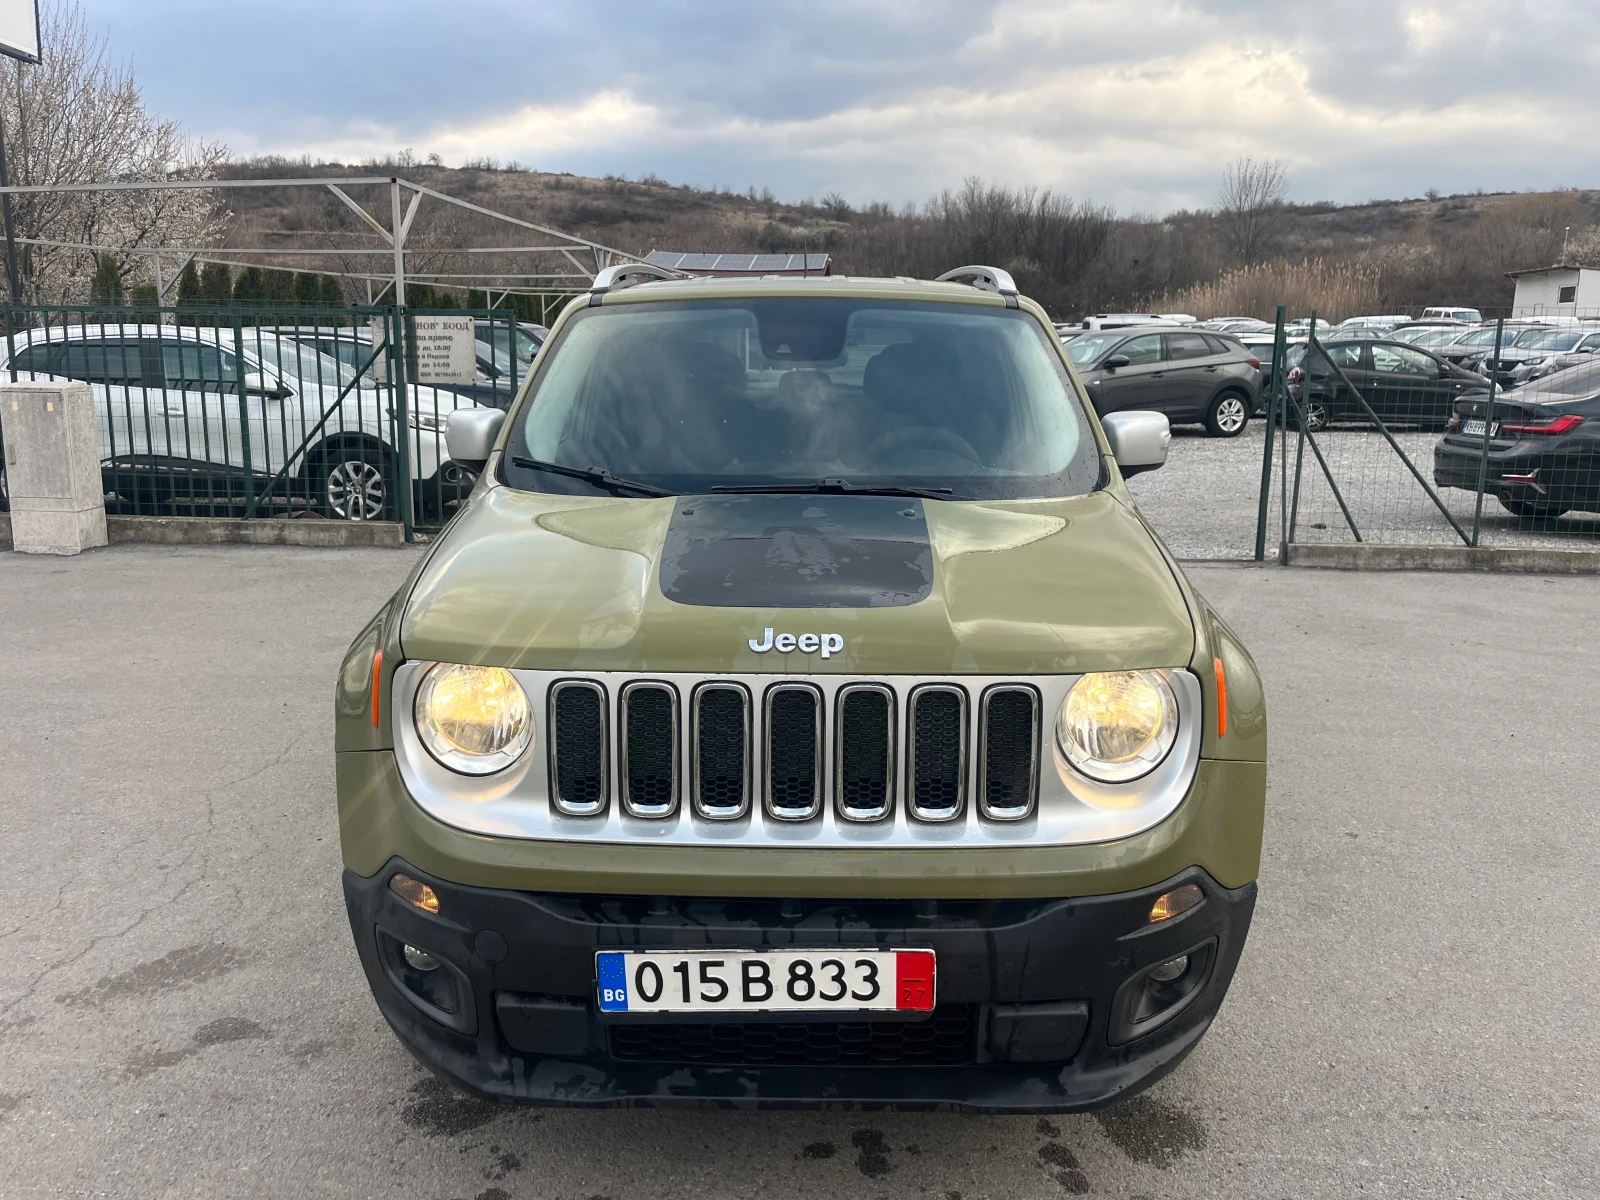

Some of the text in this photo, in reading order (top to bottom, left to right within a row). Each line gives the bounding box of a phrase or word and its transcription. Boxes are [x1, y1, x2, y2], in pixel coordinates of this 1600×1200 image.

[443, 322, 469, 331] ЕООД
[748, 627, 844, 660] Jeep
[603, 988, 625, 1002] BG
